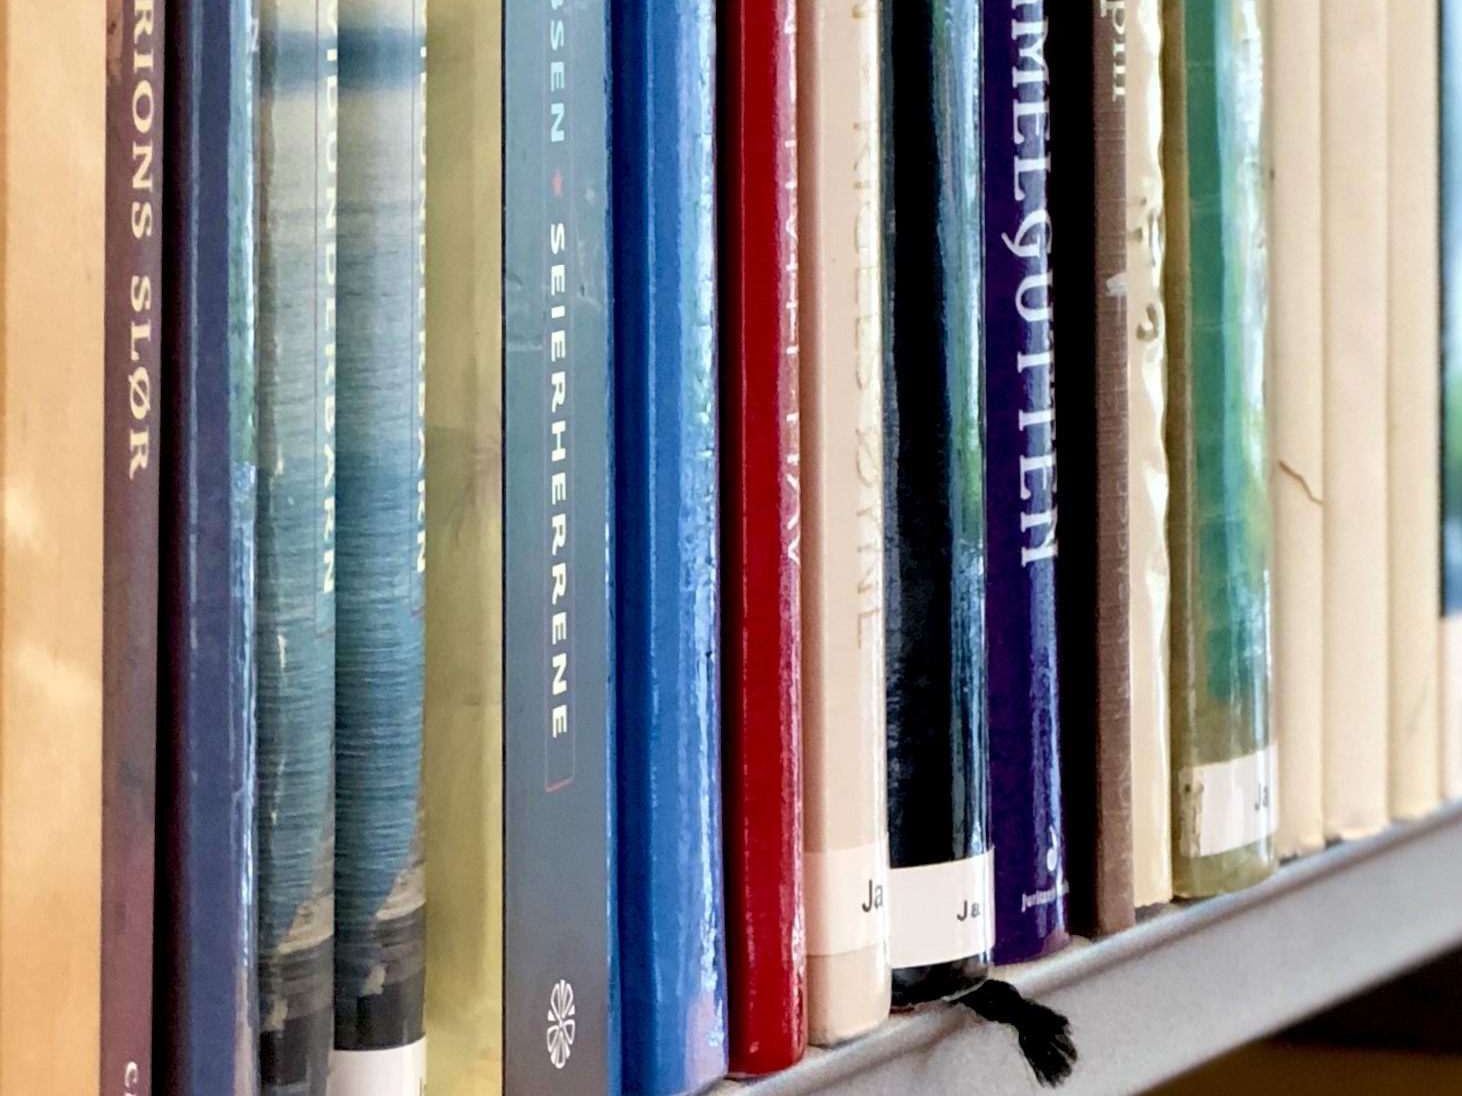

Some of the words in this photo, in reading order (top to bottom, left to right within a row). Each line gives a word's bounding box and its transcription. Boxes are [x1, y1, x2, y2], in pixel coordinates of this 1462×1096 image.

[128, 275, 153, 481] SLØR
[550, 221, 570, 740] SEIERHERRENE
[1253, 781, 1270, 812] Ja
[861, 878, 884, 913] Ja
[956, 899, 981, 922] Ja
